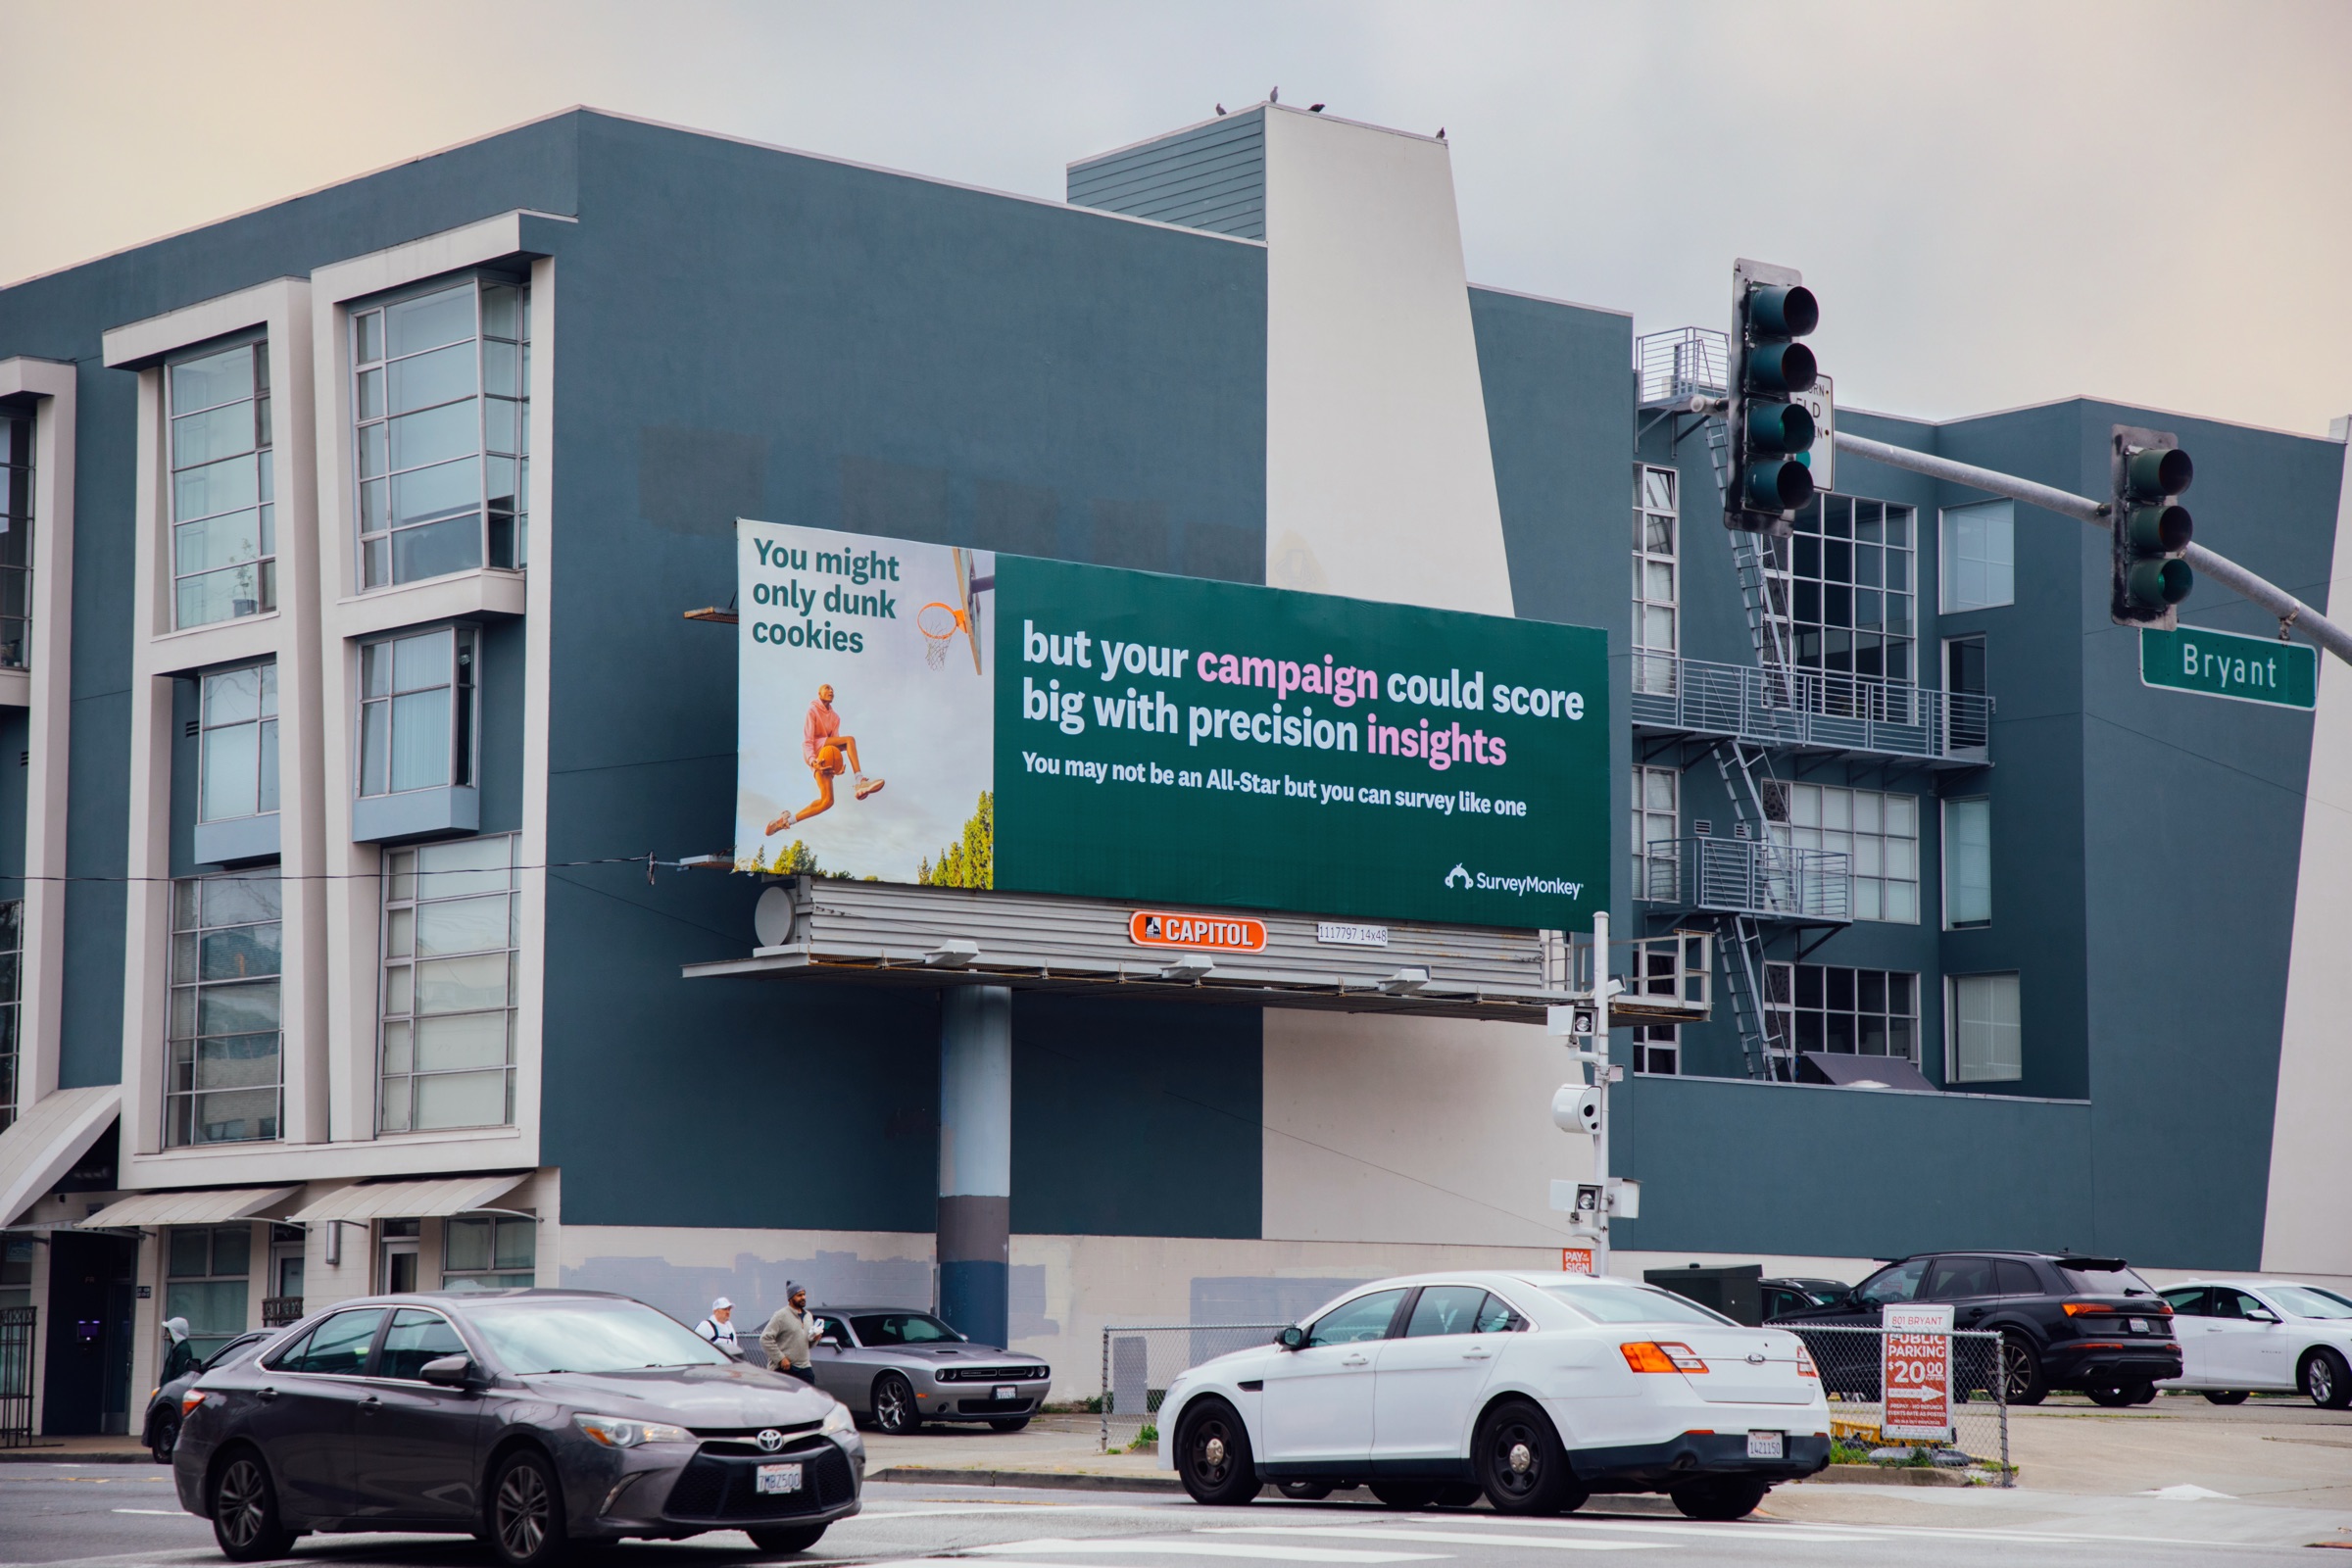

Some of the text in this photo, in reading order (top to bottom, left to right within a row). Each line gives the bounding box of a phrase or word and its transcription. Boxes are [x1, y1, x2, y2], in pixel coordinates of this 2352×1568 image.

[753, 538, 900, 586] You might
[753, 578, 896, 619] only dunk
[753, 619, 863, 654] cookies
[1023, 619, 1585, 720] but your campaign could score
[2183, 643, 2277, 688] Bryant
[1023, 677, 1507, 770] big with precision insights
[1022, 751, 1527, 817] You may not be an All-Star but you can survey like one
[1476, 871, 1581, 901] SurveyMonkey
[1165, 918, 1254, 947] CAPITOL
[1319, 926, 1387, 943] 1117797 14x48
[1565, 1251, 1584, 1262] PAY
[1565, 1262, 1590, 1274] SIGN
[1891, 1316, 1943, 1326] 801 BRYANT
[1888, 1345, 1945, 1358] PARKING
[1889, 1333, 1945, 1345] PUBLIC
[759, 1473, 800, 1490] 7MBZ500
